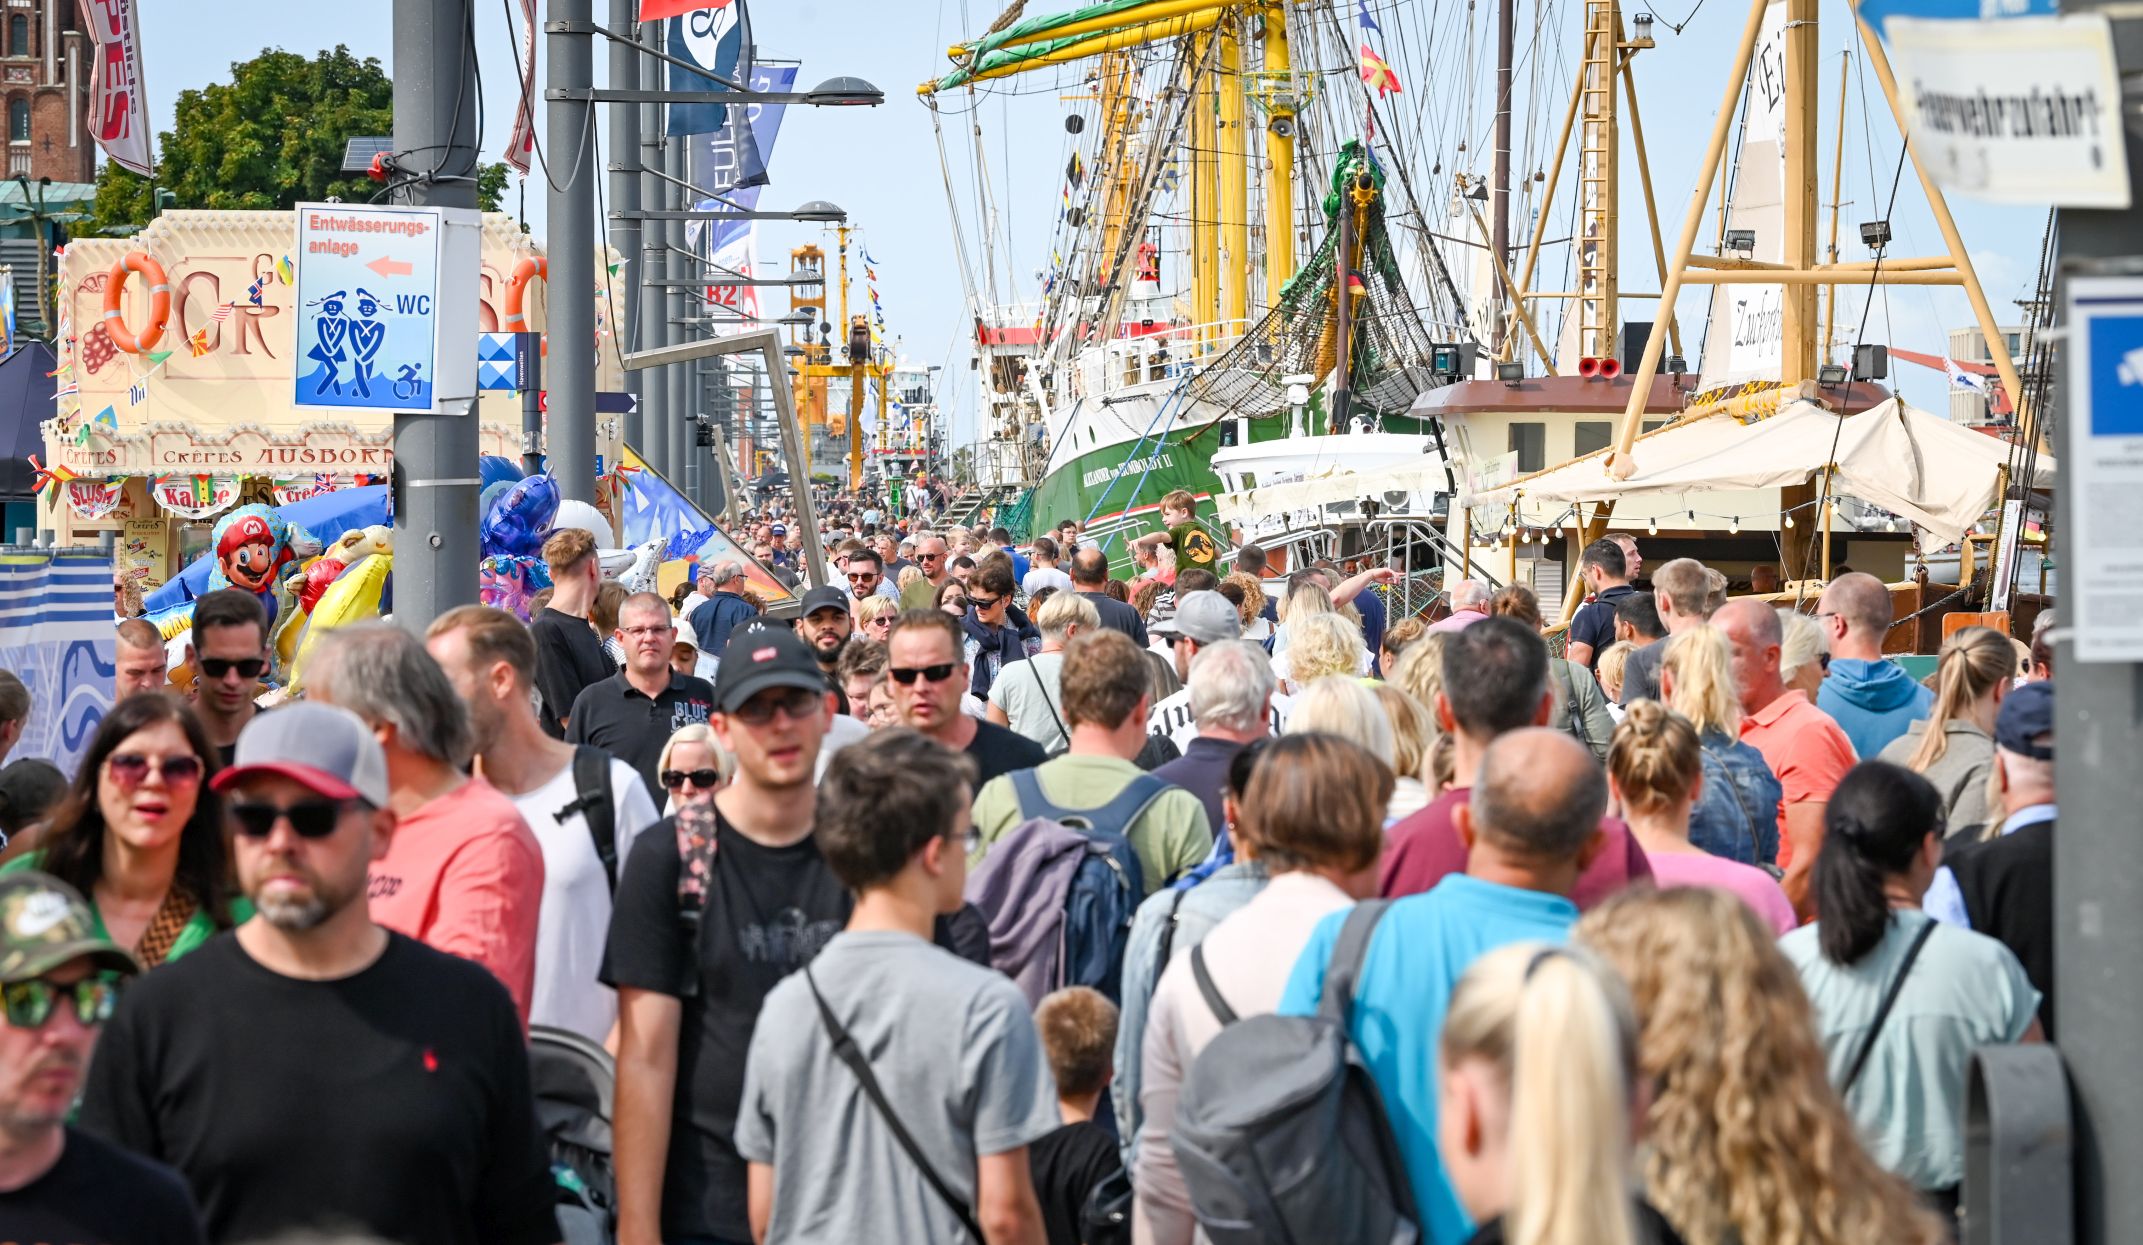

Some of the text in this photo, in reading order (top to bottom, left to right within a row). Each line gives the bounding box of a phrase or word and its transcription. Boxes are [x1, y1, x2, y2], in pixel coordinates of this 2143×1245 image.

[309, 214, 430, 237] Entwässerungs-
[308, 238, 359, 257] anlage
[706, 281, 737, 305] B2
[396, 294, 430, 315] WC
[1162, 453, 1174, 468] II
[674, 701, 708, 721] BLUE
